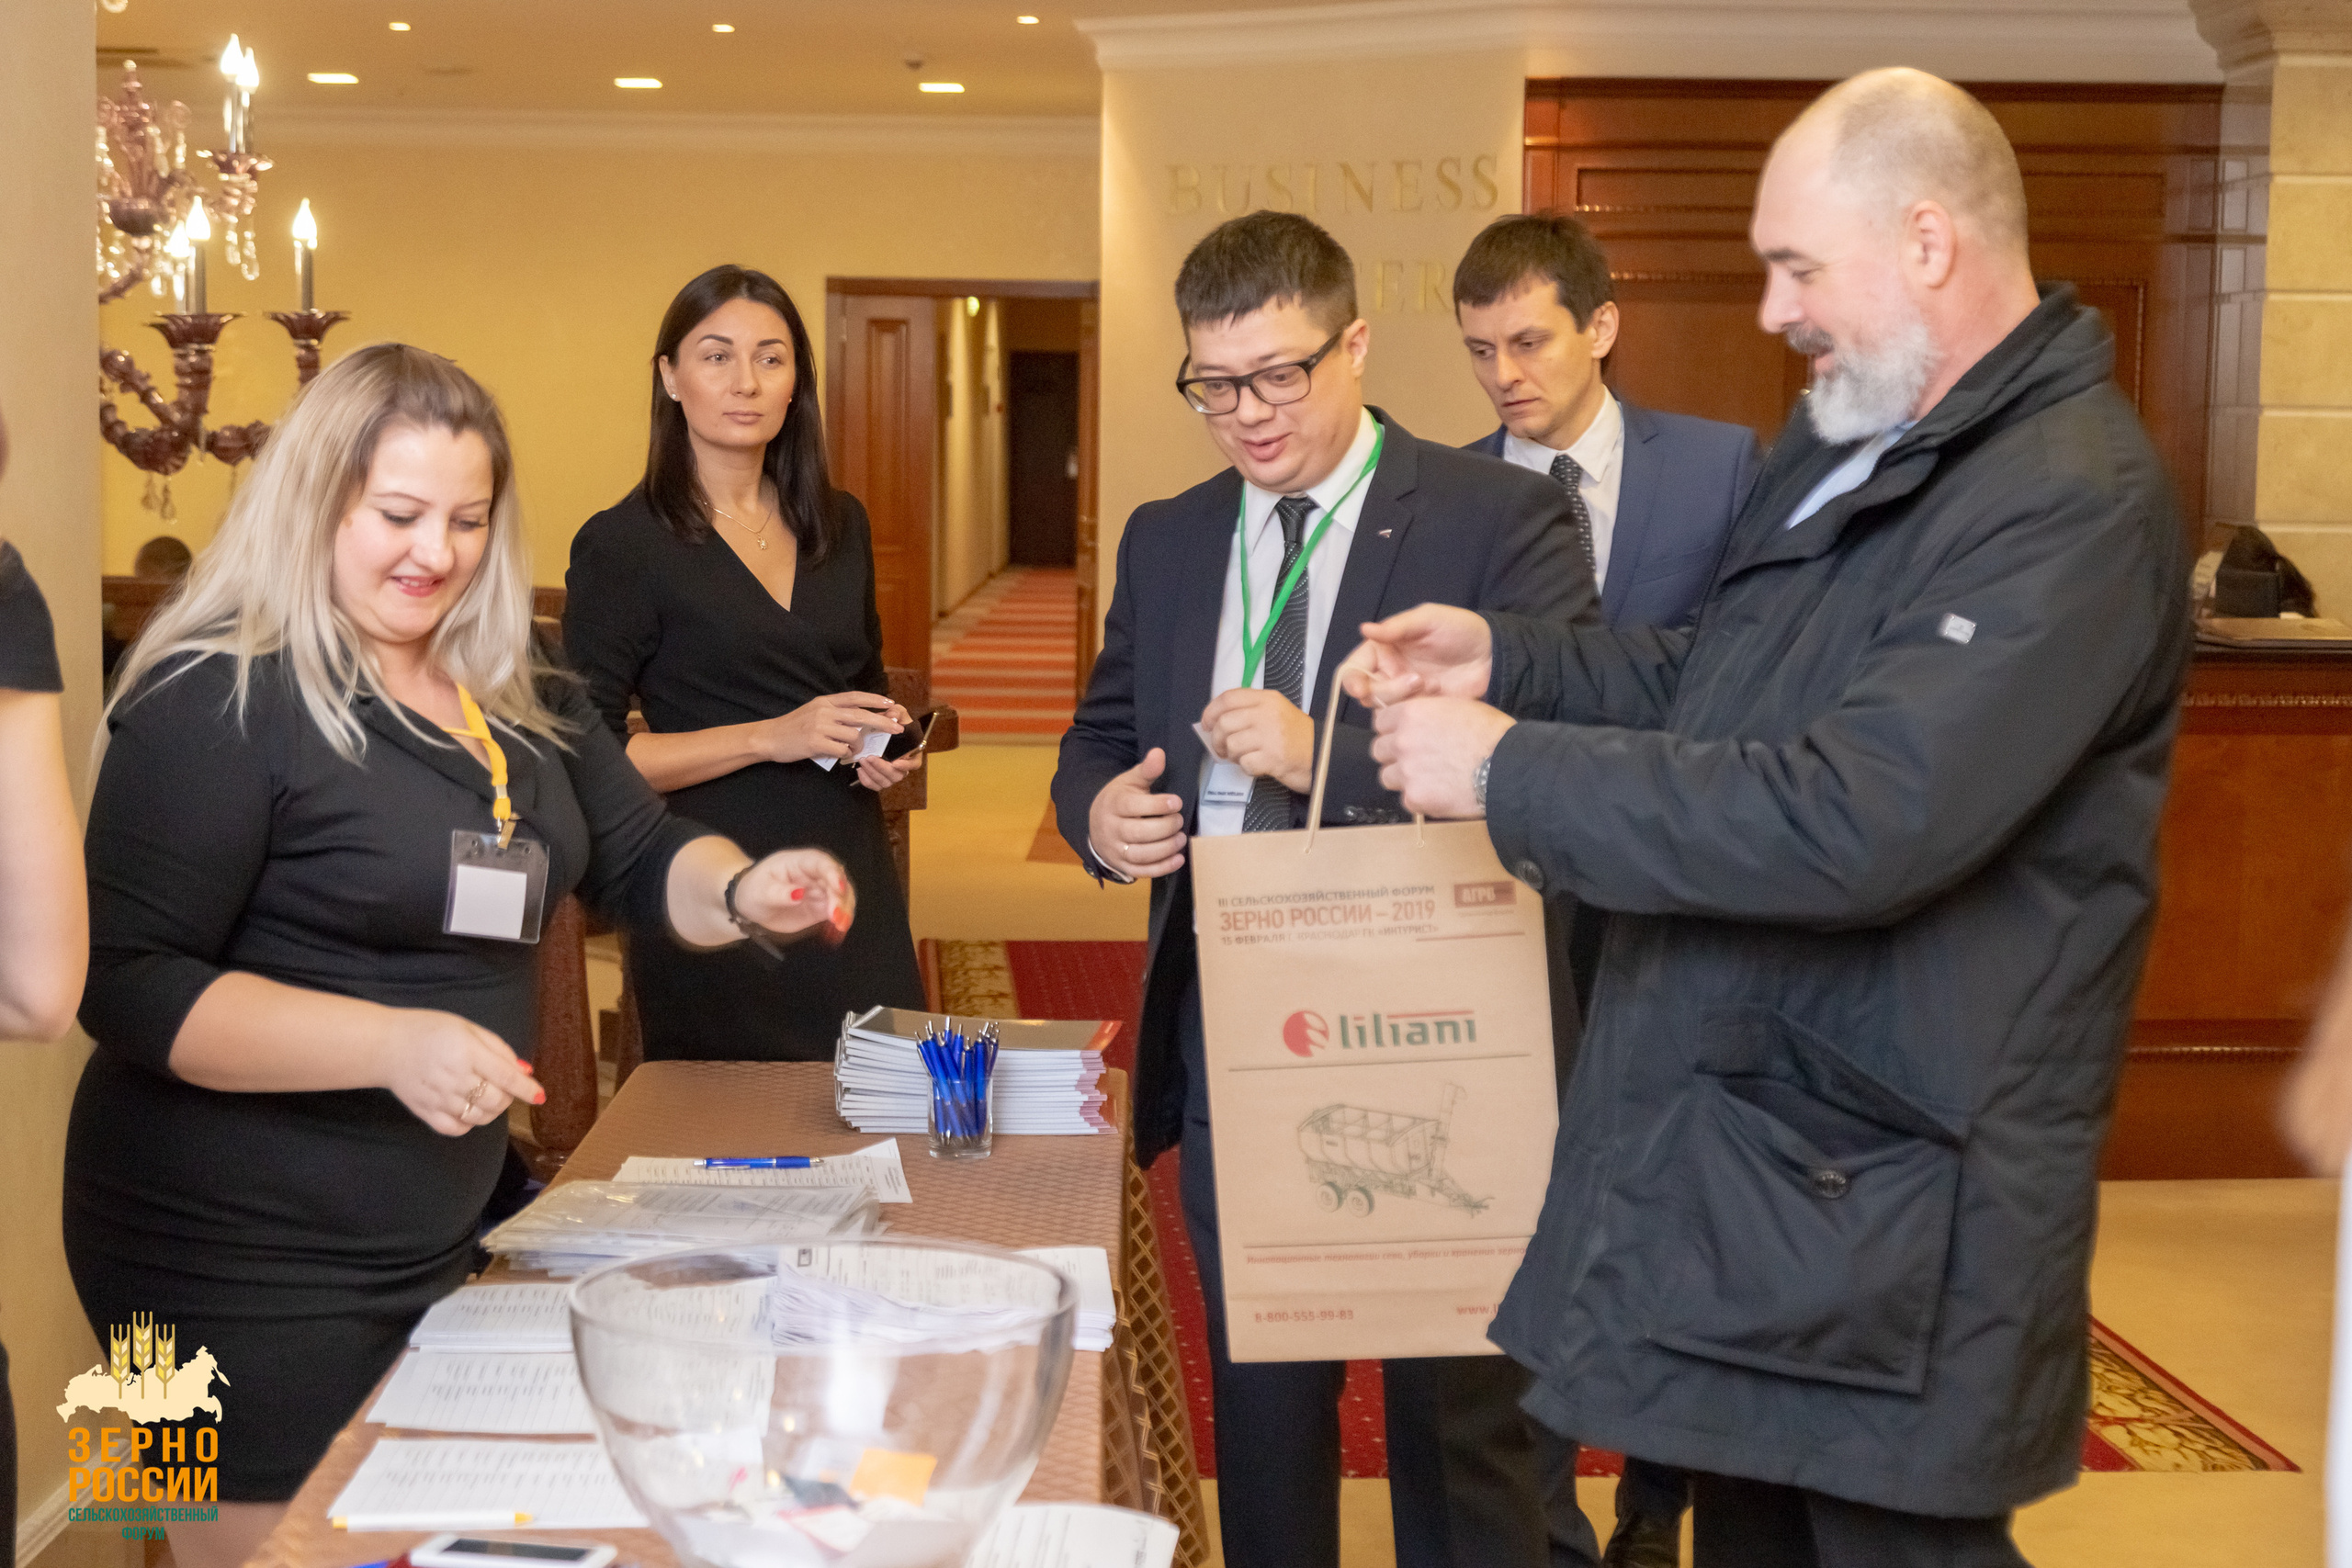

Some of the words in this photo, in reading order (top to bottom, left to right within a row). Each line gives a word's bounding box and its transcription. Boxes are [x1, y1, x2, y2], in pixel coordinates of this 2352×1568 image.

[1164, 153, 1499, 217] BUSINESS
[1231, 886, 1389, 907] СЕЛЬСКОХОЗЯЙСТВЕННЫЙ
[1392, 886, 1435, 897] ФОРУМ
[1220, 909, 1285, 931] ЗЕРНО
[1291, 904, 1373, 928] РОССИИ
[1392, 899, 1436, 921] 2019
[1221, 936, 1233, 945] 15
[1235, 933, 1285, 945] ФЕВРАЛЯ
[1340, 1010, 1476, 1049] liliani
[1255, 1309, 1354, 1323] 8-800-555-99-83
